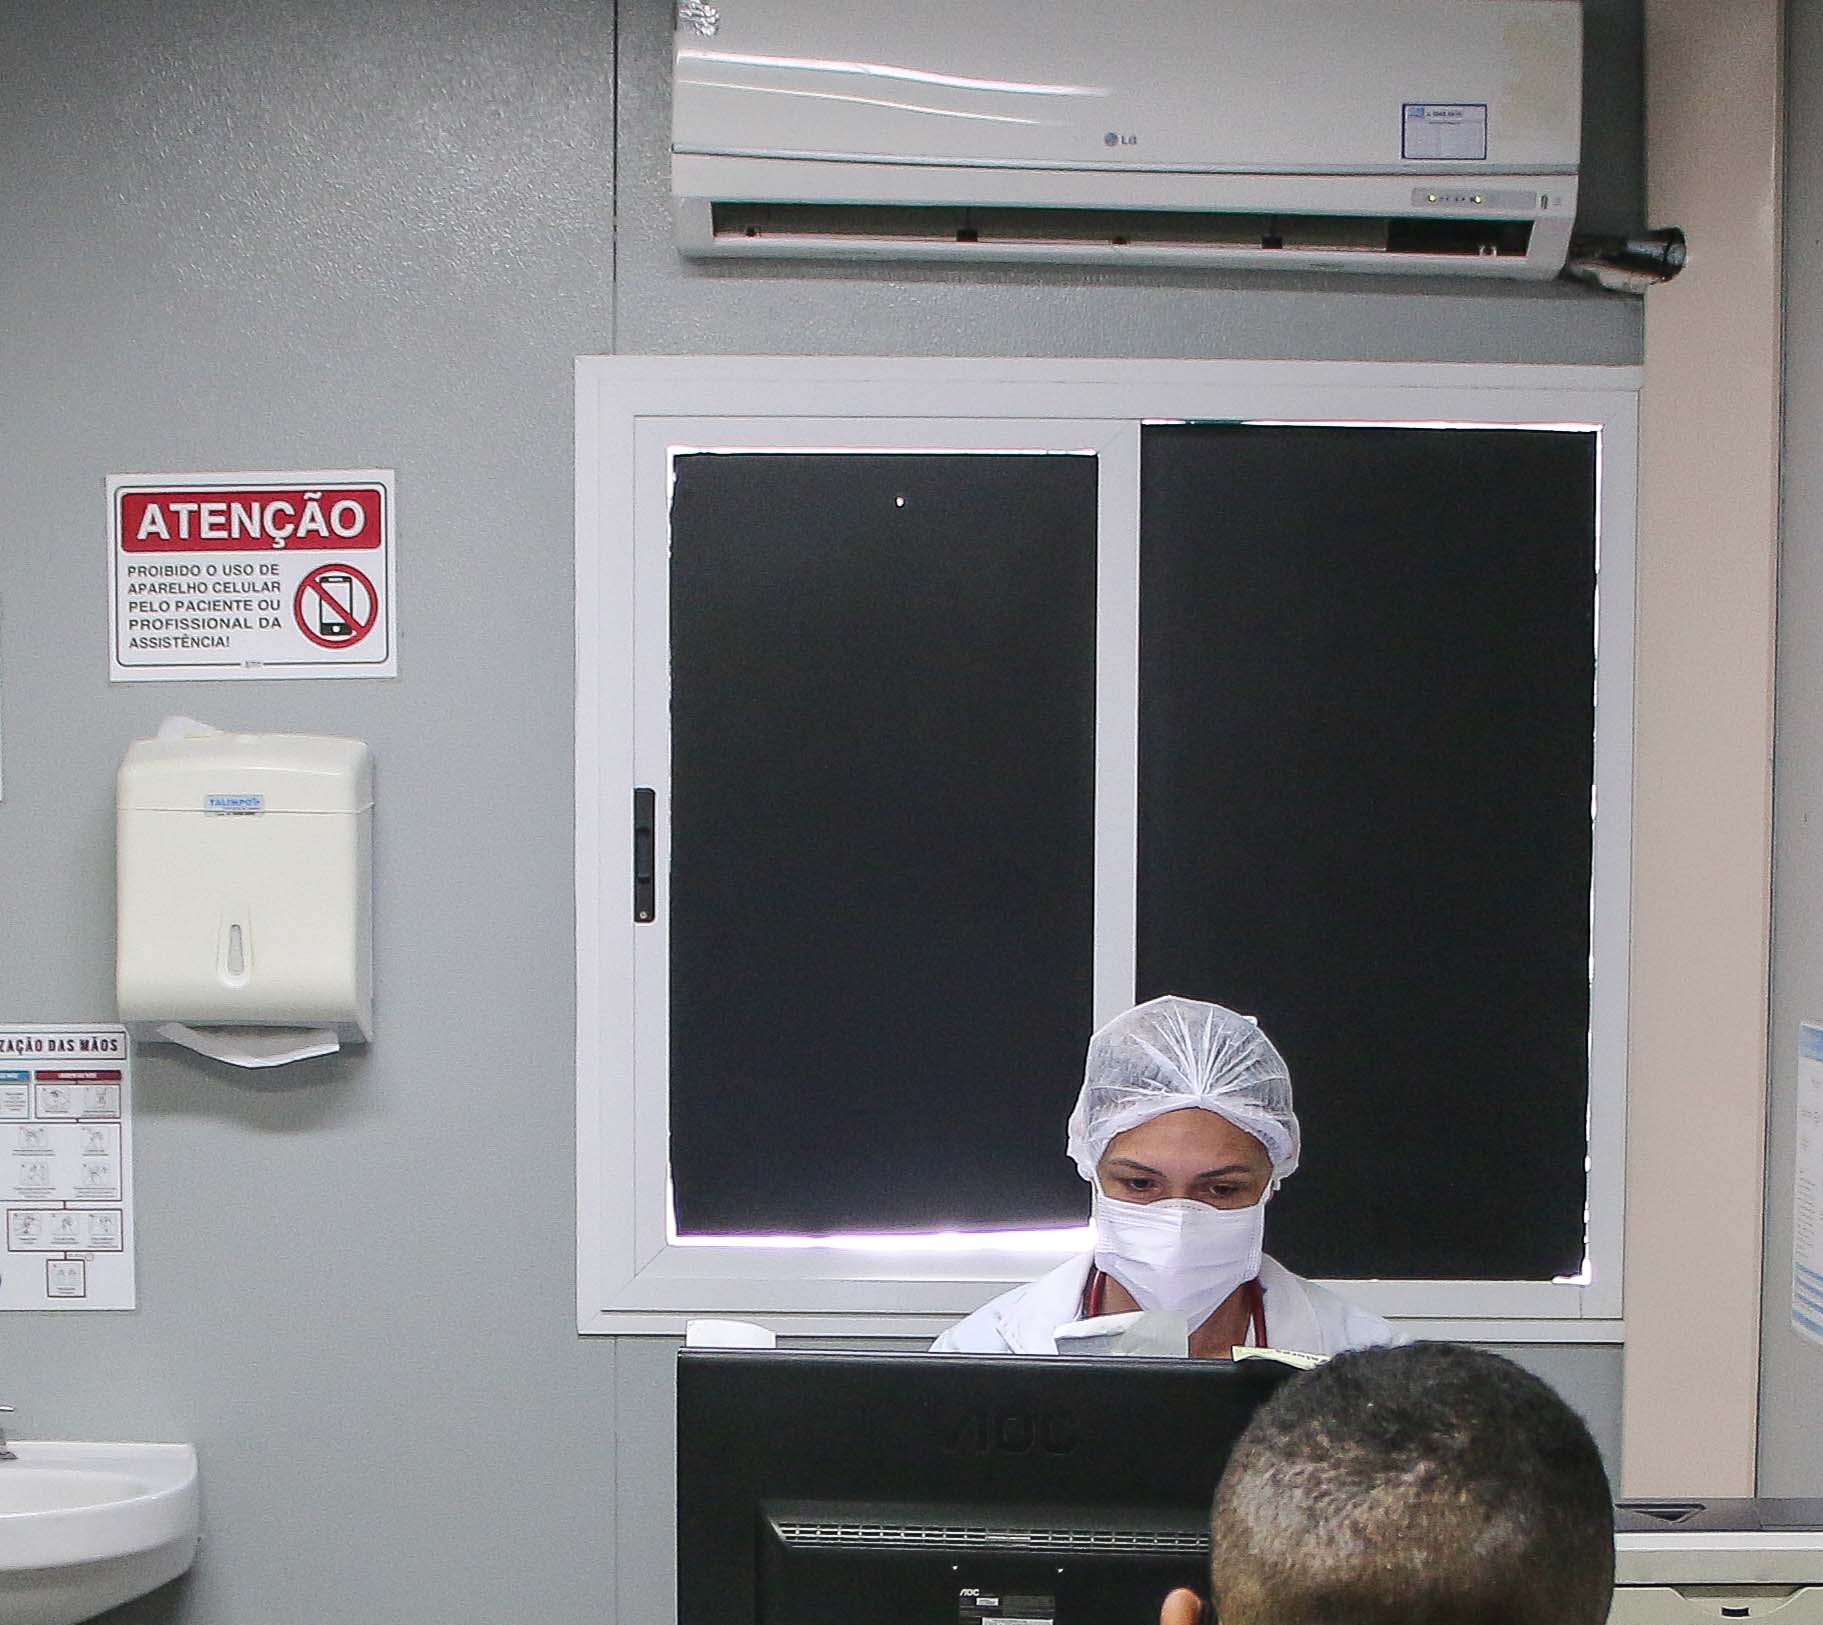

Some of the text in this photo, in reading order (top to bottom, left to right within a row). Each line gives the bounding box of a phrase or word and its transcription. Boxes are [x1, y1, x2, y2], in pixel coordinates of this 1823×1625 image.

[1121, 135, 1137, 145] LG
[135, 492, 366, 549] ATENÇÃO
[128, 564, 279, 577] PROIBIDO O USO DE
[128, 581, 281, 594] APARELHO CELULAR
[128, 599, 280, 612] PELO PACIENTE OU
[128, 617, 281, 630] PROFISSIONAL DA
[128, 633, 230, 649] ASSISTÊNCIA!
[48, 1039, 75, 1052] DAS
[80, 1036, 118, 1052] MÃOS
